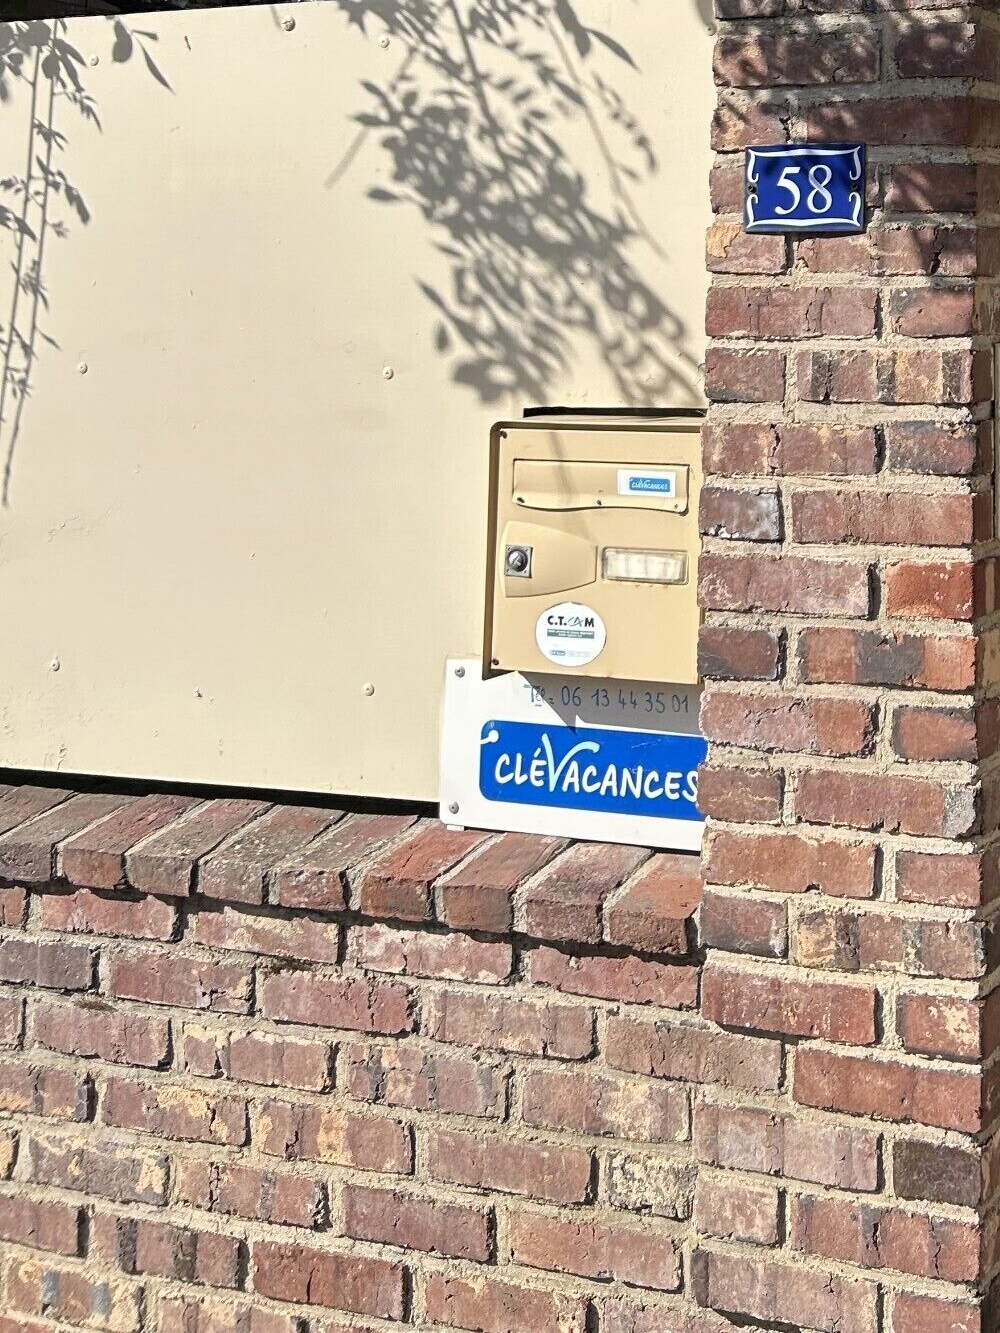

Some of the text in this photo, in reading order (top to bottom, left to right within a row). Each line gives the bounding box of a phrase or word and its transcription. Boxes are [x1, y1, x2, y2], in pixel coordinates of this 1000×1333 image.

[774, 164, 833, 215] 58
[561, 685, 582, 707] 06
[591, 688, 610, 708] 13
[618, 689, 638, 709] 44
[645, 692, 666, 714] 35
[671, 694, 689, 714] 01
[495, 732, 699, 803] CLÉVACANCES
